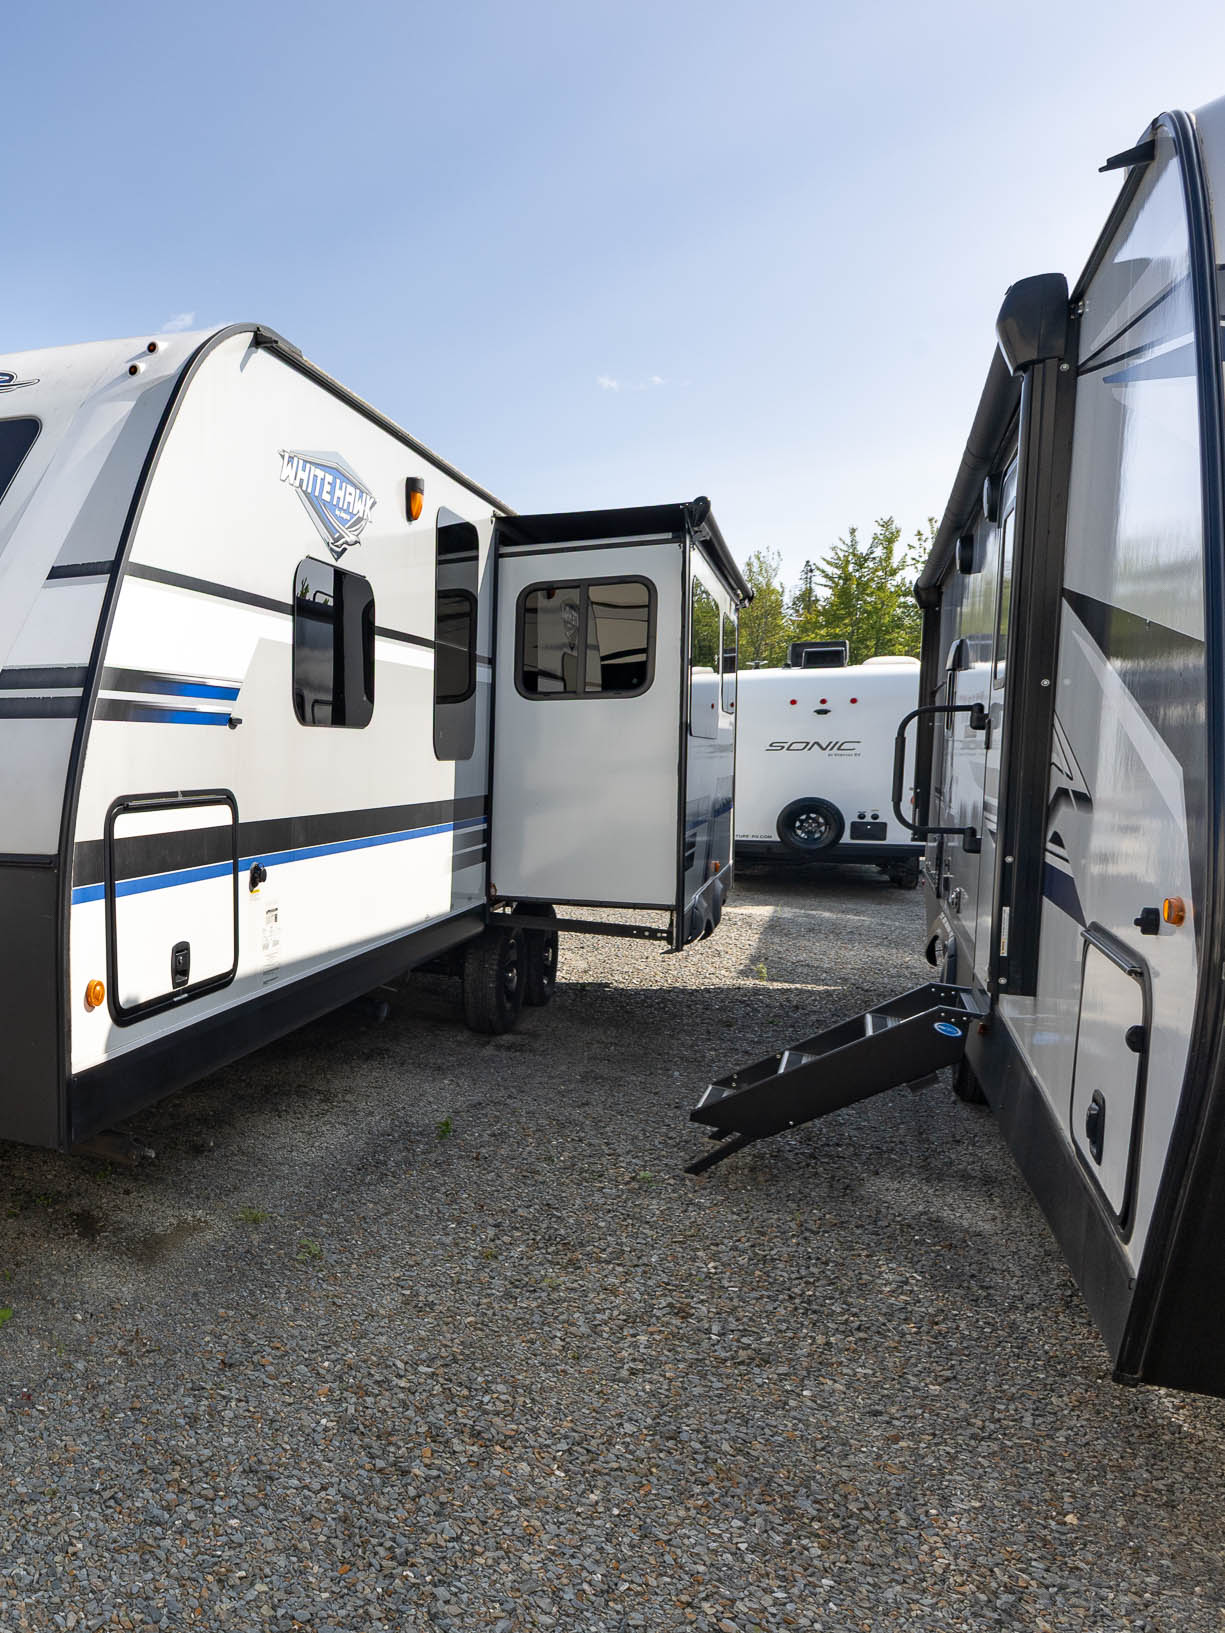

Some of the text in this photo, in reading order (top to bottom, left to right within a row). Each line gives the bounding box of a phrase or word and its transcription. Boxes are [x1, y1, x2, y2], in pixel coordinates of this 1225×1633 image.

[278, 449, 377, 521] WHITE HAWK
[765, 740, 862, 751] SONIC
